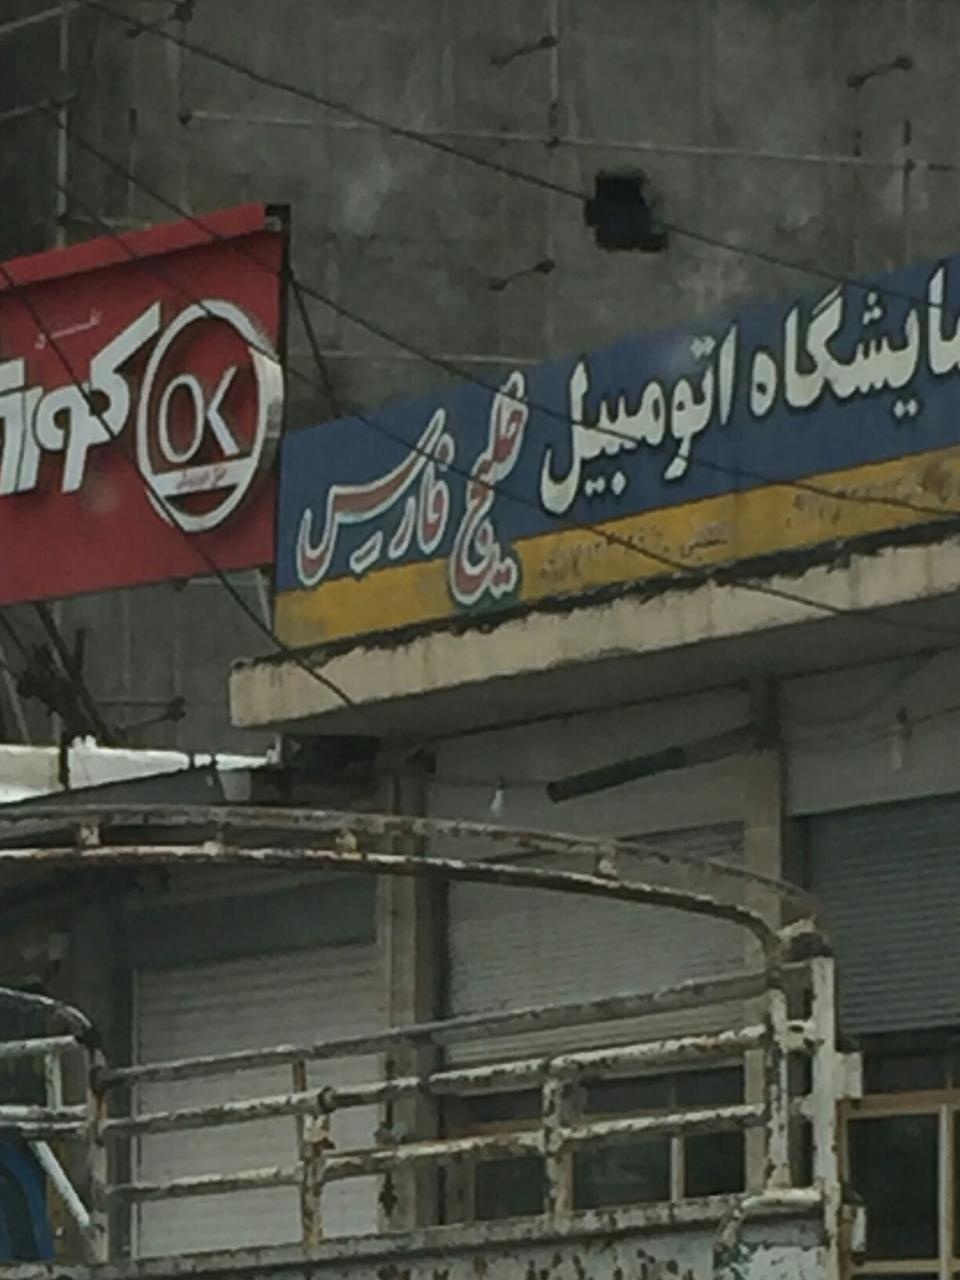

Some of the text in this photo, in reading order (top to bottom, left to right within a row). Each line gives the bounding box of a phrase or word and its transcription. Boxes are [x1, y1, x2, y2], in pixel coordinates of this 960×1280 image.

[159, 365, 240, 464] OK
[296, 407, 456, 588] فارس
[540, 323, 738, 515] اتومبیل
